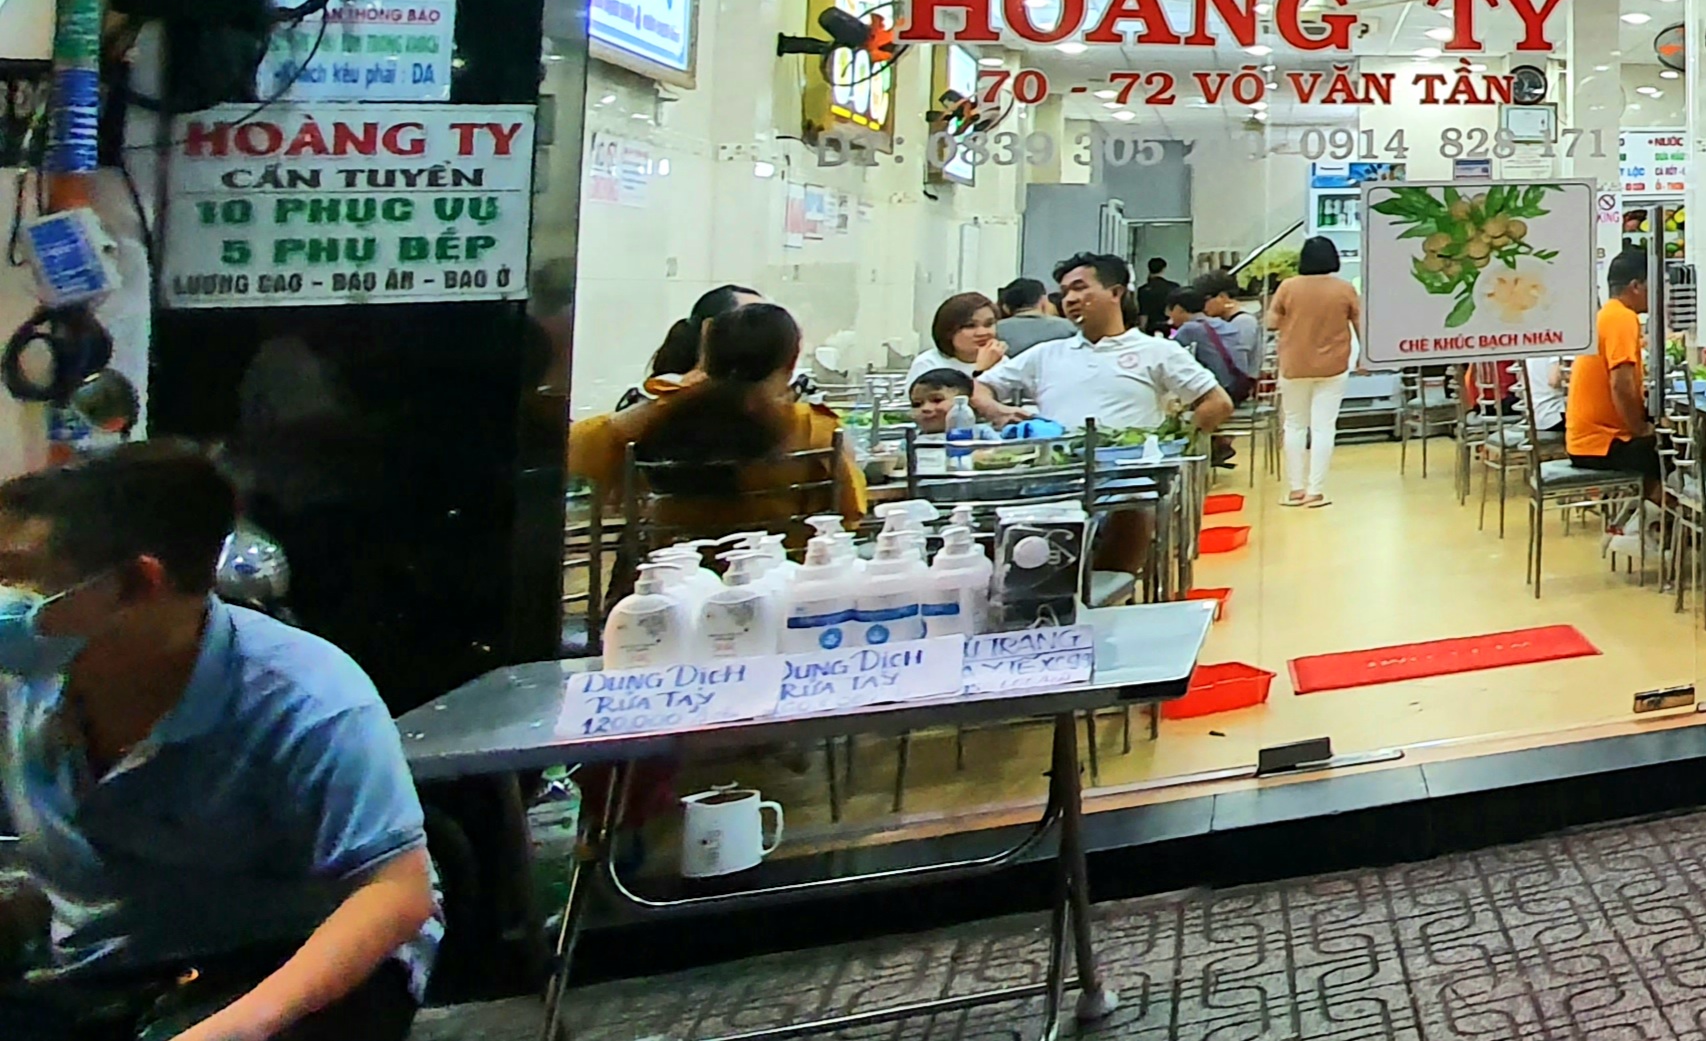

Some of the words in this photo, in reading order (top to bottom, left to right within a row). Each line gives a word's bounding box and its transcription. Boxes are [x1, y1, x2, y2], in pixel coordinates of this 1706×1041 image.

[977, 68, 1046, 107] 70
[1108, 70, 1176, 107] 72
[1193, 64, 1267, 106] VÕ
[1289, 64, 1396, 106] VĂN
[1413, 57, 1515, 106] TẦN
[183, 114, 426, 158] HOÀNG
[450, 122, 523, 156] TY
[927, 129, 1055, 169] 0839
[1300, 128, 1409, 161] 0914
[1439, 127, 1516, 159] 828
[1539, 128, 1607, 158] 171
[197, 198, 253, 224] 10
[274, 197, 414, 229] PHỤC
[433, 196, 499, 226] VỤ
[220, 238, 250, 265] 5
[272, 236, 376, 269] PHỤ
[399, 227, 498, 262] BẾP
[444, 269, 487, 289] BAO
[1433, 333, 1475, 351] KHÚC
[1478, 332, 1518, 351] BẠCH
[582, 671, 664, 694] DUNG
[657, 690, 716, 714] TAY
